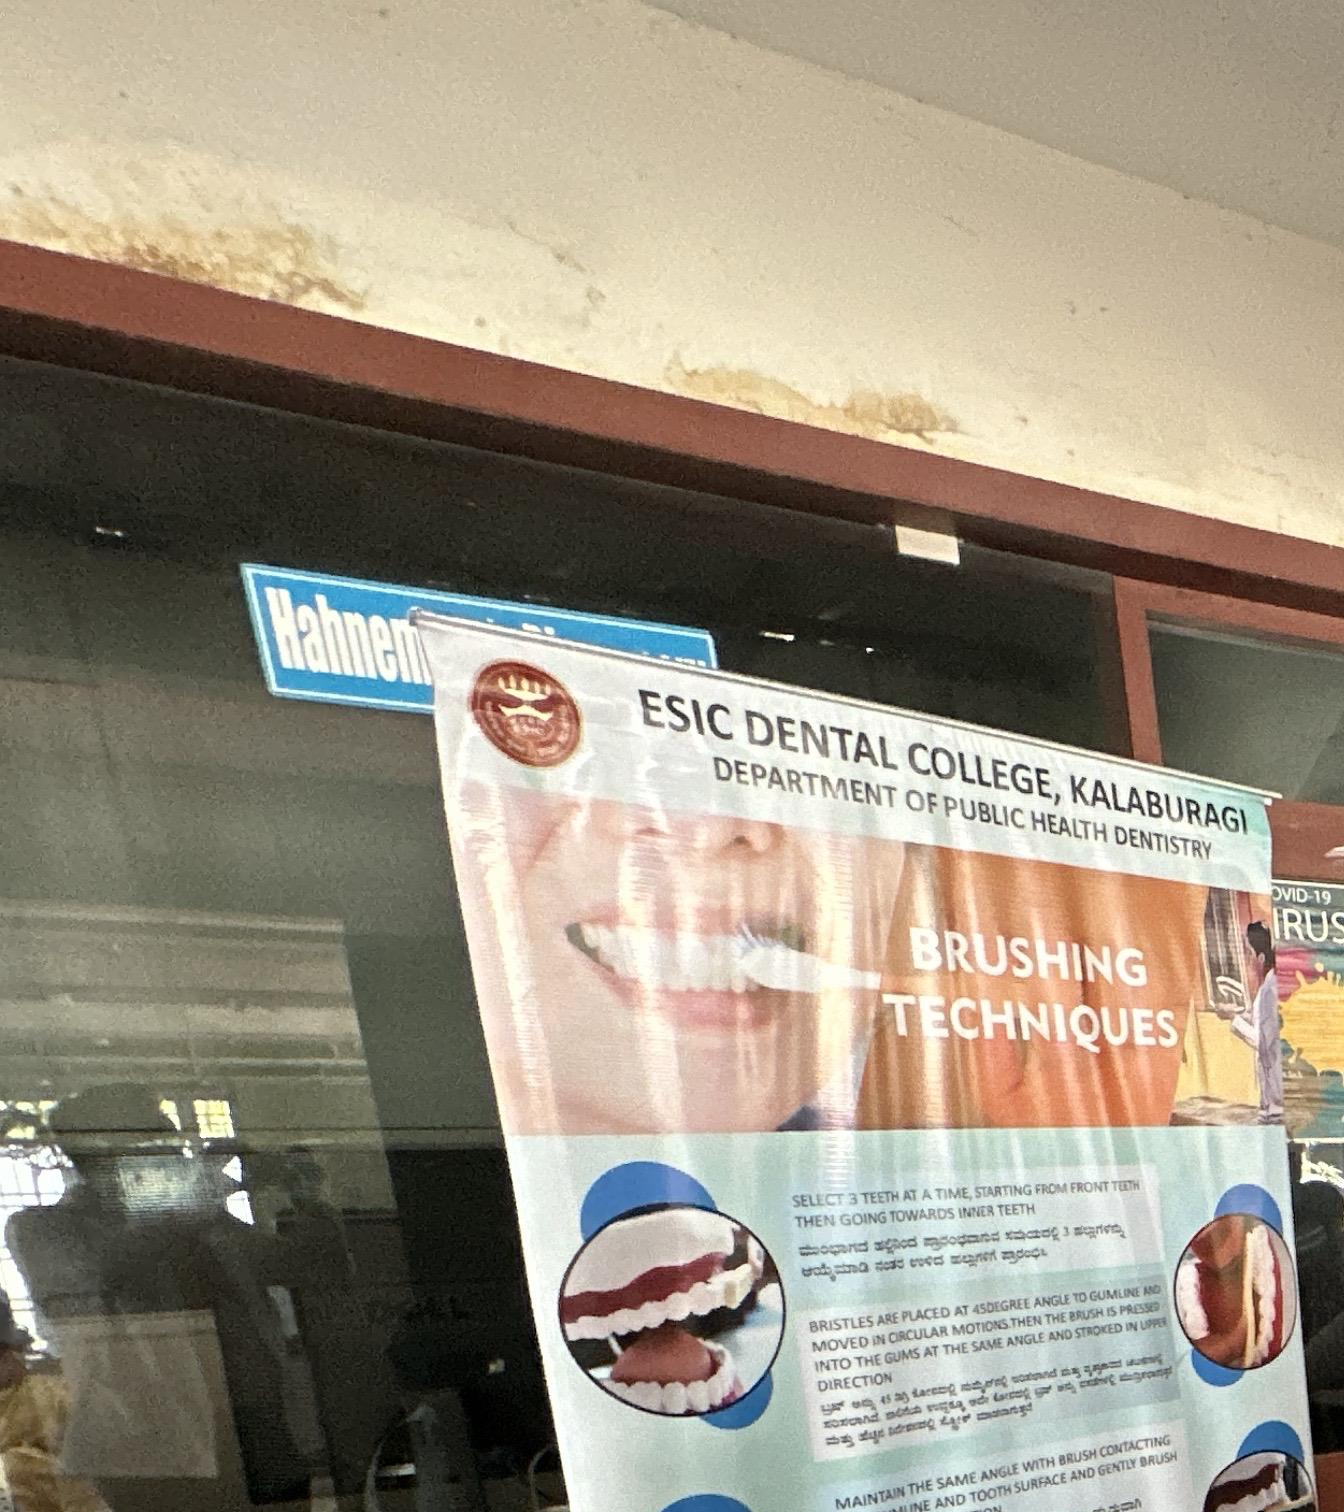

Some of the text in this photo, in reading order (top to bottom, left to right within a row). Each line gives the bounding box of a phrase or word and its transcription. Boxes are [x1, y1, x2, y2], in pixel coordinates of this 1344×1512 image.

[638, 689, 733, 740] ESIC
[745, 710, 898, 770] DENTAL
[907, 743, 1061, 804] COLLEGE,
[1070, 774, 1249, 834] KALABURAGI
[714, 758, 1213, 860] DEPARTMENT OF PUBLIC HEALTH DENTISTRY
[1272, 886, 1331, 905] OVID-19
[909, 927, 1147, 987] BRUSHING
[882, 995, 1178, 1054] TECHNIQUES
[792, 1180, 1140, 1208] SELECT 3 TEETH AT A TIME, STARTING FROM FRONT TEETH
[795, 1203, 1035, 1228] THEN GOING TOWARDS INNER TEETH
[809, 1315, 873, 1333] BRISTLES
[877, 1311, 899, 1325] ARE
[902, 1307, 950, 1323] PLACED
[954, 1304, 968, 1317] AT
[1033, 1294, 1069, 1309] ANGLE
[1072, 1292, 1086, 1304] TO
[1089, 1287, 1140, 1303] GUMLINE
[1143, 1284, 1161, 1297] AND
[811, 1335, 868, 1353] MOVED
[872, 1332, 885, 1346] IN
[889, 1326, 948, 1344] CIRCULAR
[1045, 1312, 1066, 1325] THE
[1069, 1308, 1103, 1322] BRUSH
[1107, 1307, 1116, 1318] IS
[1119, 1301, 1160, 1316] PRESSED
[814, 1316, 1168, 1373] INTO THE GUMS AT THE SAME ANGLE AND STROKED IN UPPER
[818, 1372, 892, 1392] DIRECTION
[835, 1435, 1170, 1510] MAINTAIN THE SAME ANGLE WITH BRUSH CONTACTING
[935, 1495, 965, 1509] AND
[969, 1484, 1012, 1503] TOOTH
[1014, 1472, 1067, 1494] SURFACE
[1070, 1467, 1095, 1482] AND
[1098, 1460, 1136, 1476] GENTLY
[1140, 1450, 1177, 1468] BRUSH
